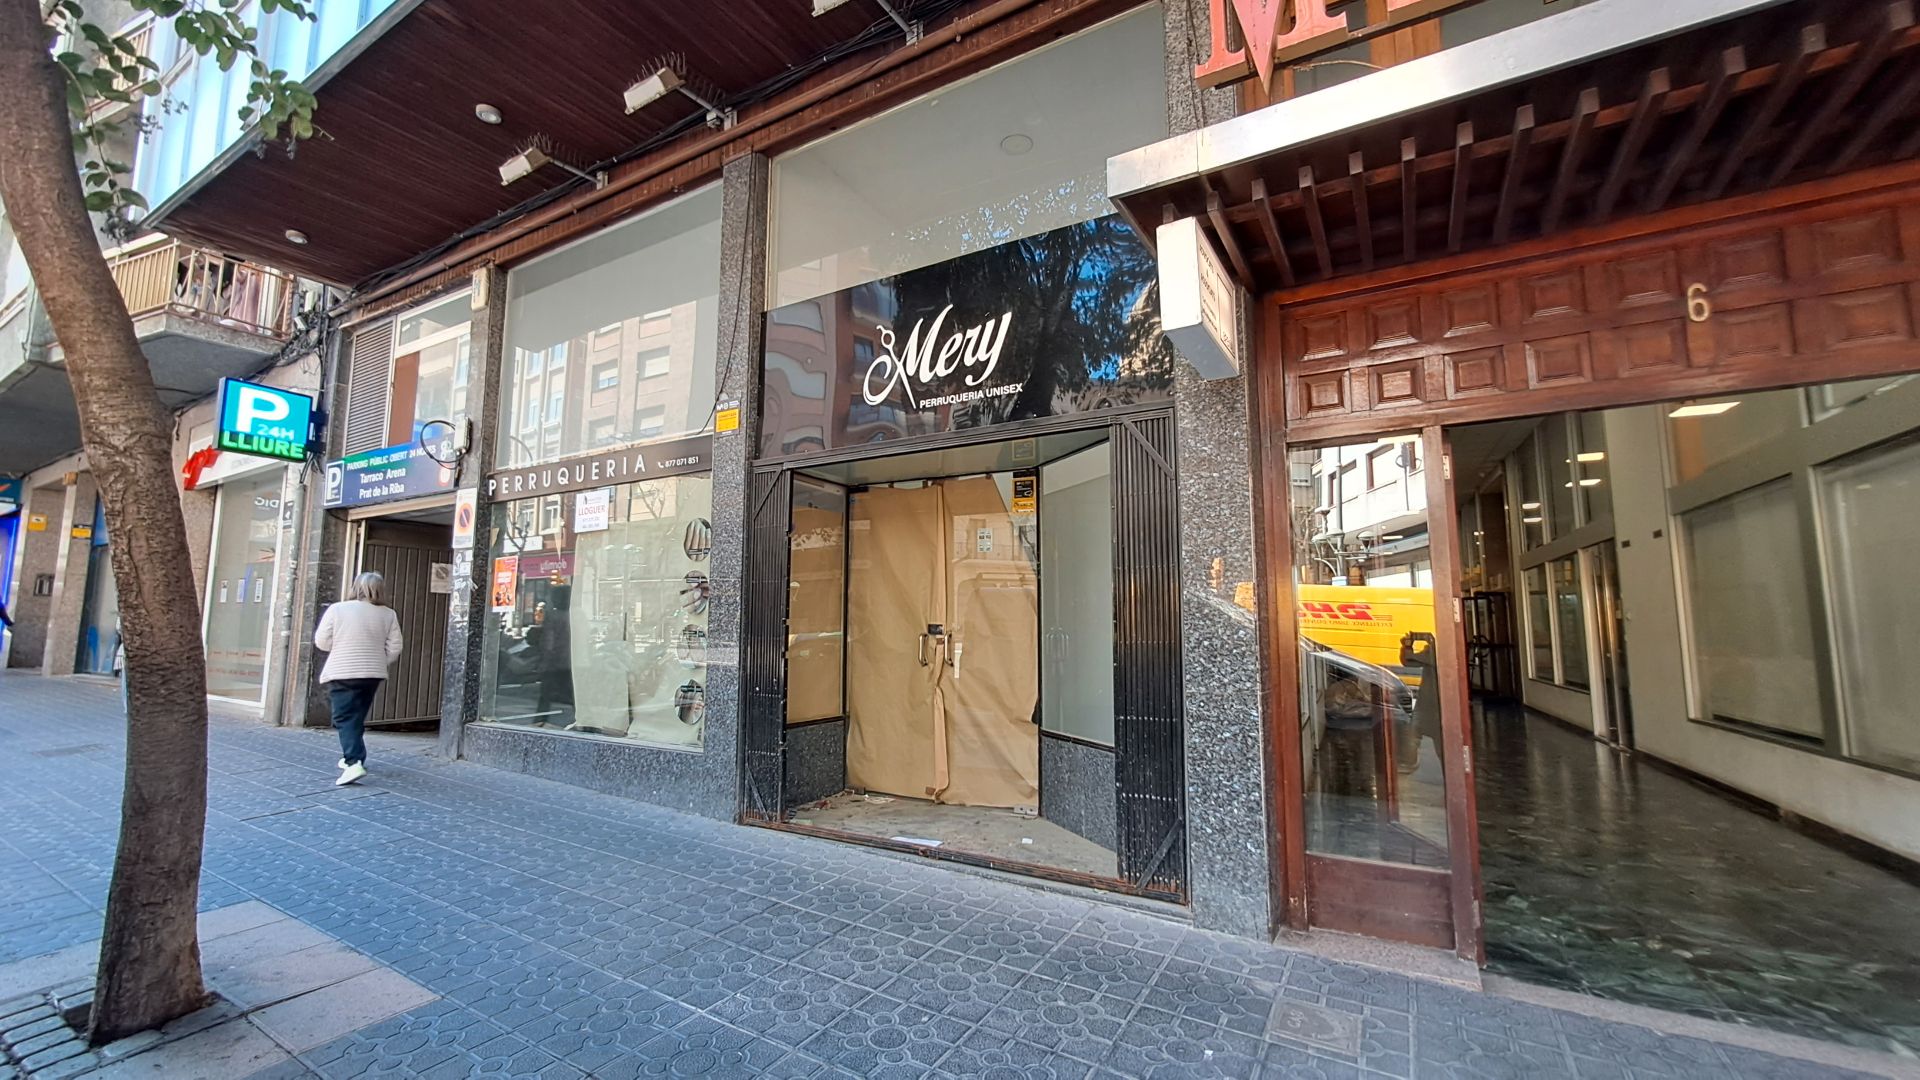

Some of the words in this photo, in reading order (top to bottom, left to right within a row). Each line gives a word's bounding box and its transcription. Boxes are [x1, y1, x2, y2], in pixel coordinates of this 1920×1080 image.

[1686, 283, 1709, 322] 6
[863, 303, 1013, 406] Mery
[919, 389, 985, 409] PERRUQUERIA
[985, 382, 1024, 398] UNISEX
[236, 386, 291, 433] P
[222, 430, 305, 459] LLIURE
[256, 423, 295, 441] 24H
[676, 457, 687, 466] 071
[687, 456, 699, 465] 851
[360, 473, 384, 484] Tarraco
[386, 467, 406, 480] Arena
[488, 454, 646, 497] PERRUQUERIA
[359, 488, 372, 500] Prat
[372, 487, 381, 497] de
[381, 485, 389, 496] la
[389, 483, 405, 494] Riba
[578, 504, 606, 516] LLOGUER
